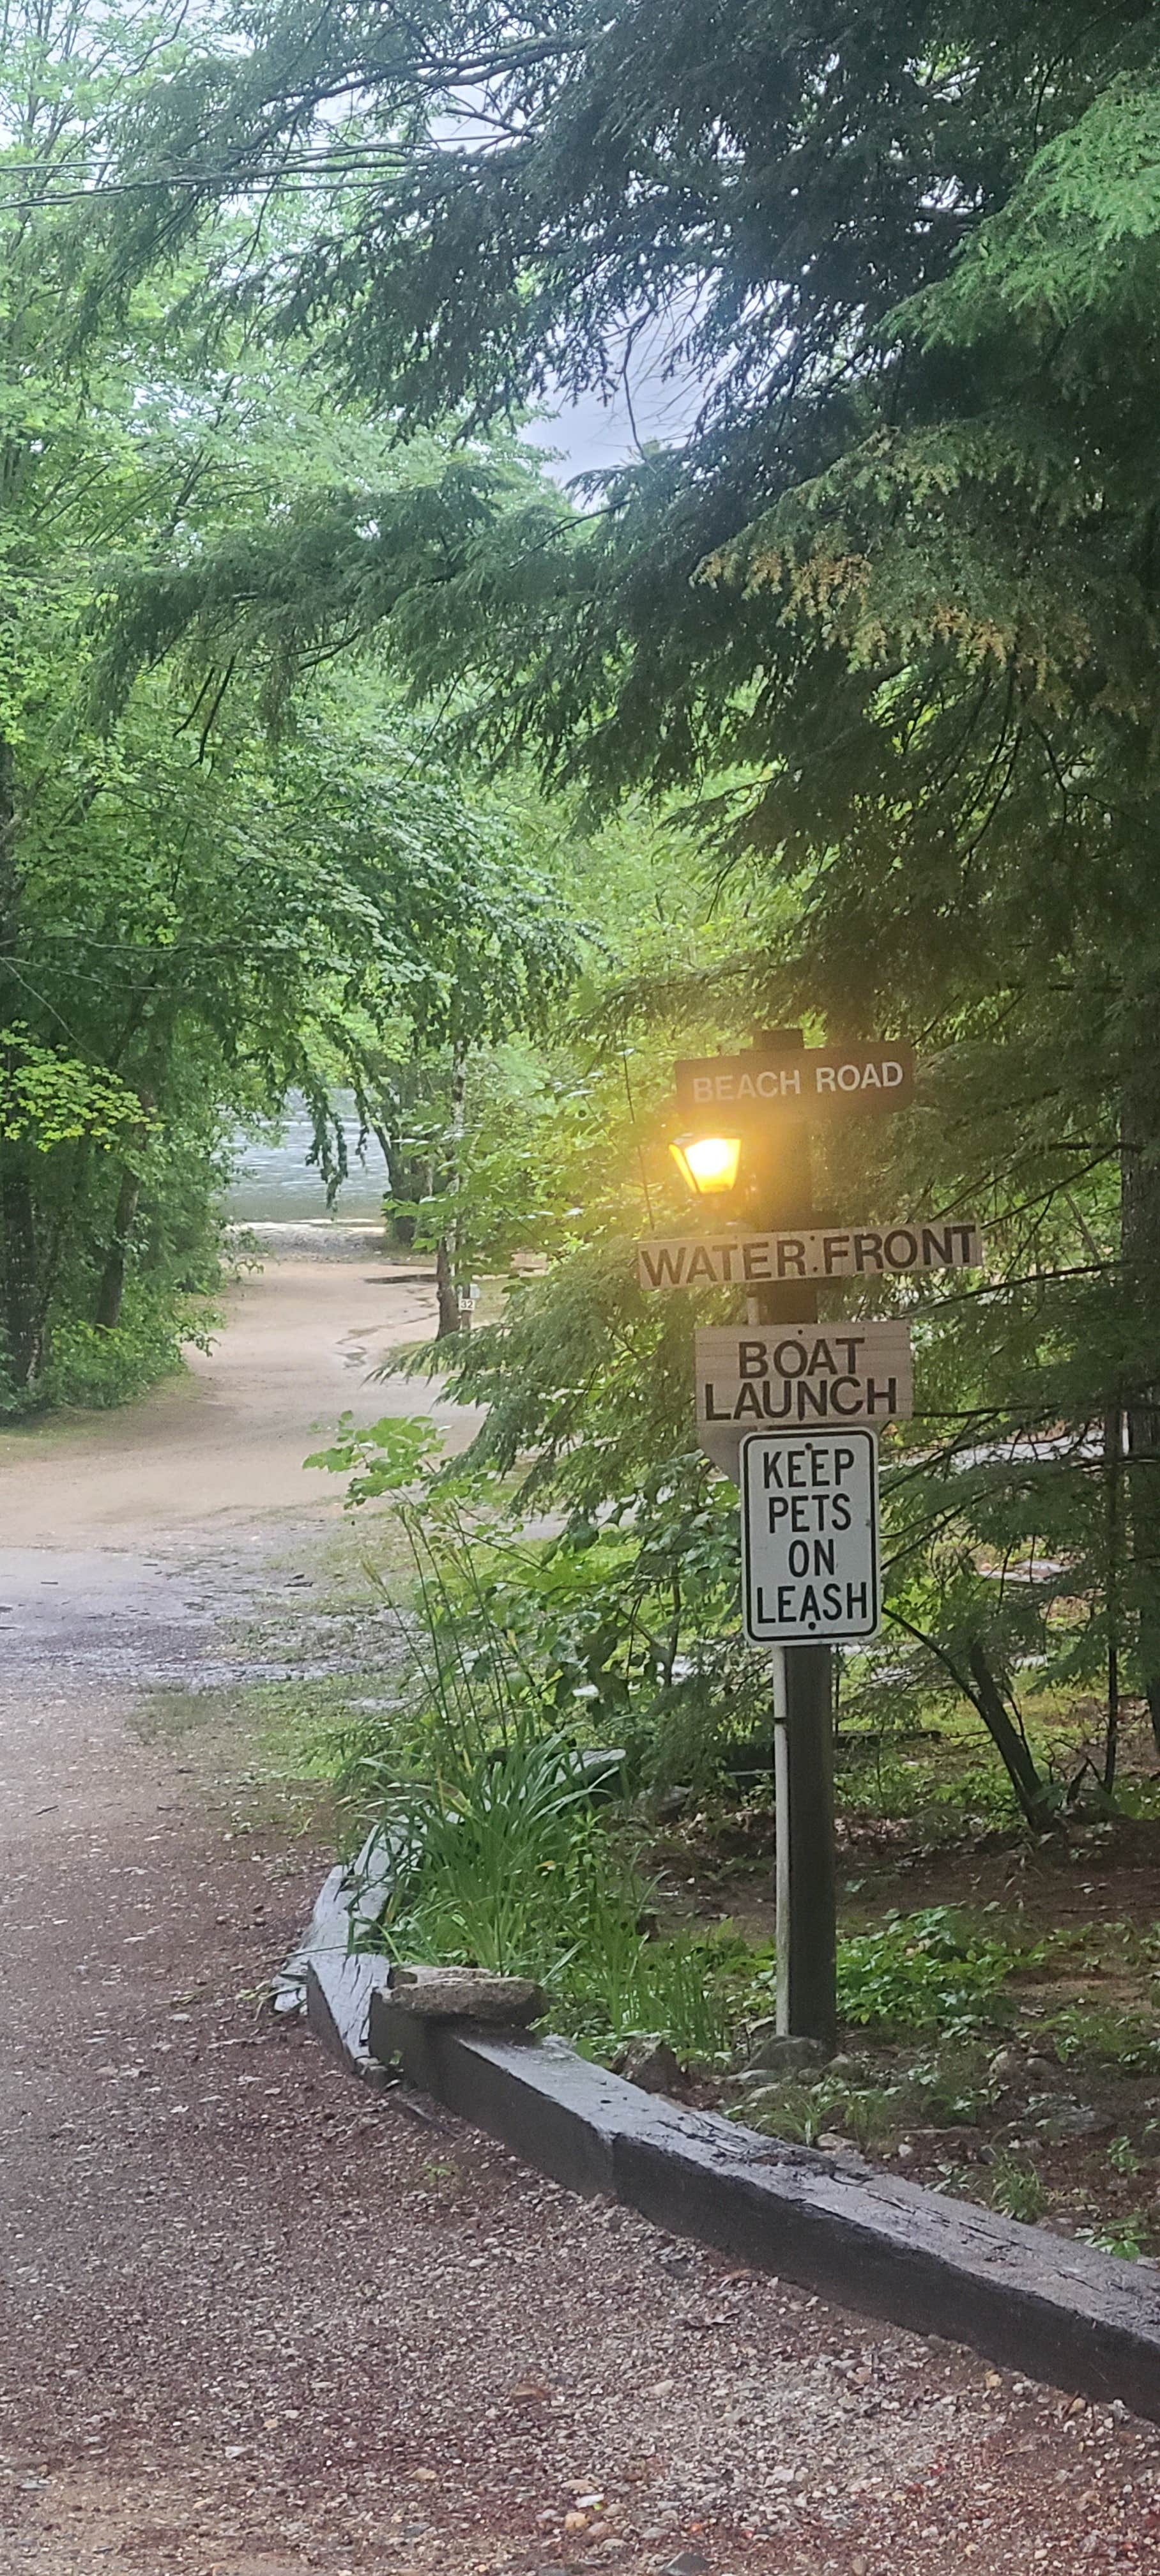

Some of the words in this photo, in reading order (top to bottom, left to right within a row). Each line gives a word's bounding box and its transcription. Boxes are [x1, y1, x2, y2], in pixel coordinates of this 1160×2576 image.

[694, 1070, 801, 1103] BEACH
[816, 1061, 904, 1093] ROAD
[641, 1239, 805, 1287] WATER
[823, 1224, 976, 1275] FRONT
[461, 1300, 473, 1308] 32
[738, 1337, 866, 1379] BOAT
[705, 1376, 897, 1421] LAUNCH
[763, 1448, 855, 1489] KEEP
[768, 1493, 852, 1533] PETS
[788, 1538, 836, 1577] ON
[757, 1582, 868, 1624] LEASH
